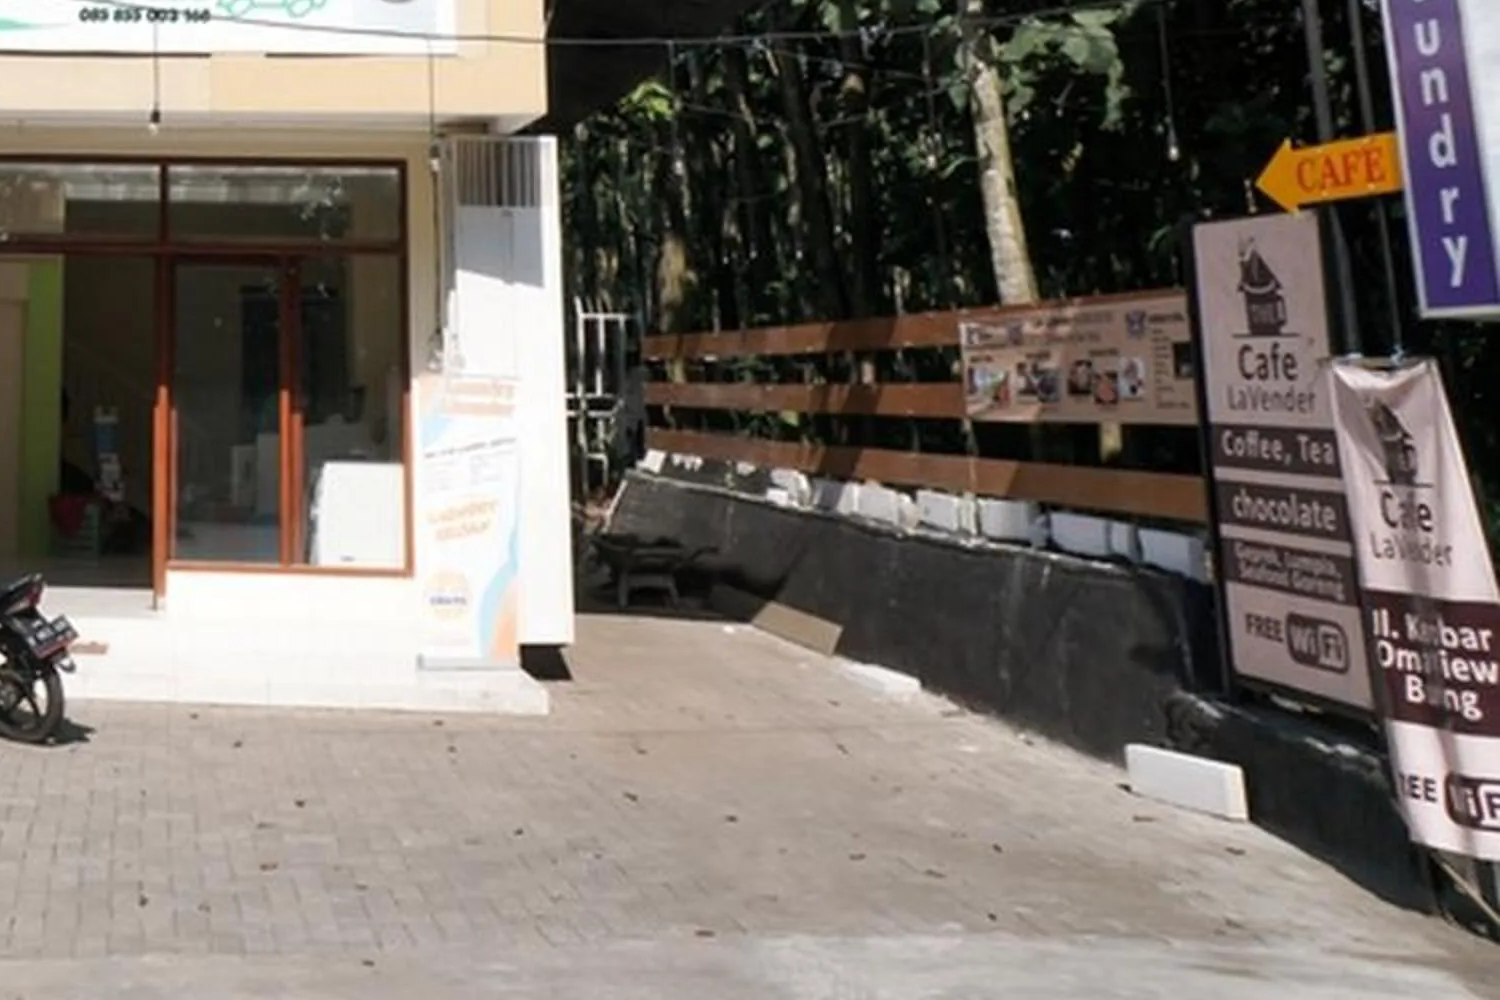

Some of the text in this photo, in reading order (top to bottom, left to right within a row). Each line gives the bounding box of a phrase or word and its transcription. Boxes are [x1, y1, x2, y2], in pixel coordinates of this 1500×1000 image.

[1237, 341, 1299, 381] Cafe
[1220, 428, 1336, 467] Coffee, Tea
[1232, 486, 1338, 533] chocolate
[1244, 612, 1285, 644] FREE
